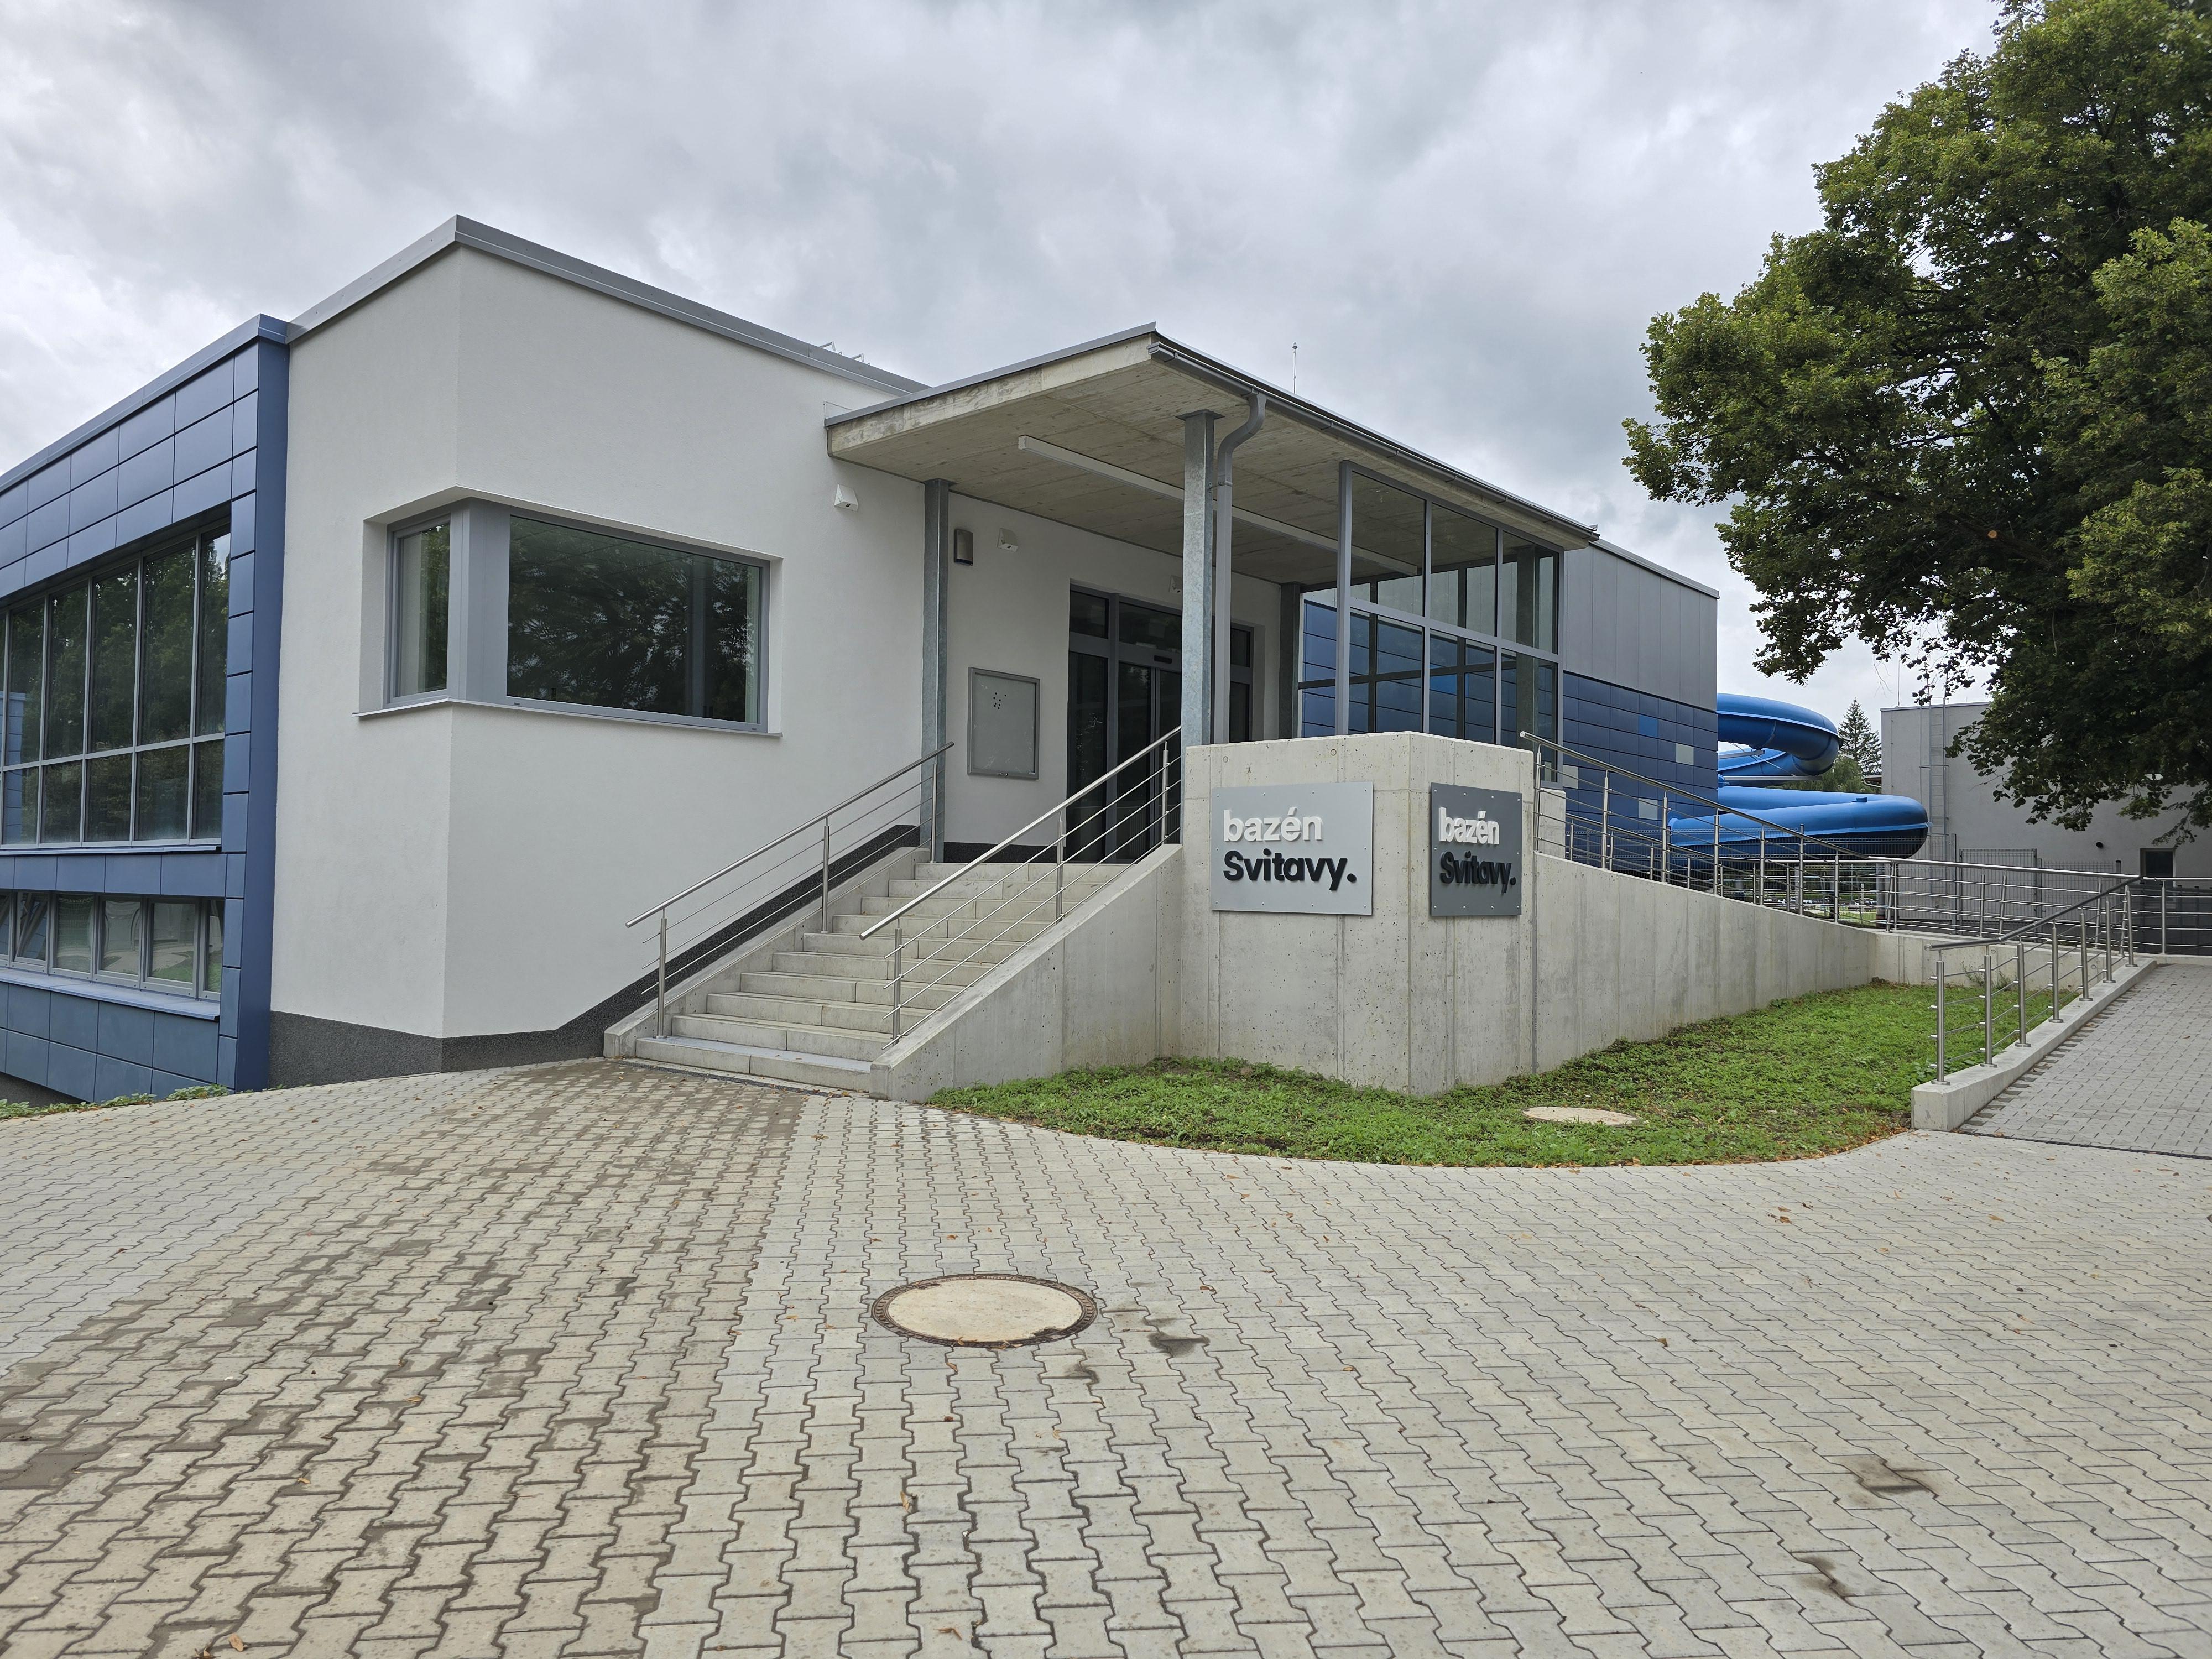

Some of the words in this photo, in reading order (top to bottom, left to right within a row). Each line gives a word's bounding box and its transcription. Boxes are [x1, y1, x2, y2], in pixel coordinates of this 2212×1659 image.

[1223, 807, 1323, 842] bazén
[1438, 807, 1500, 845] bazén
[1223, 848, 1357, 891] Svitavy.
[1439, 850, 1517, 894] Svitavy.
